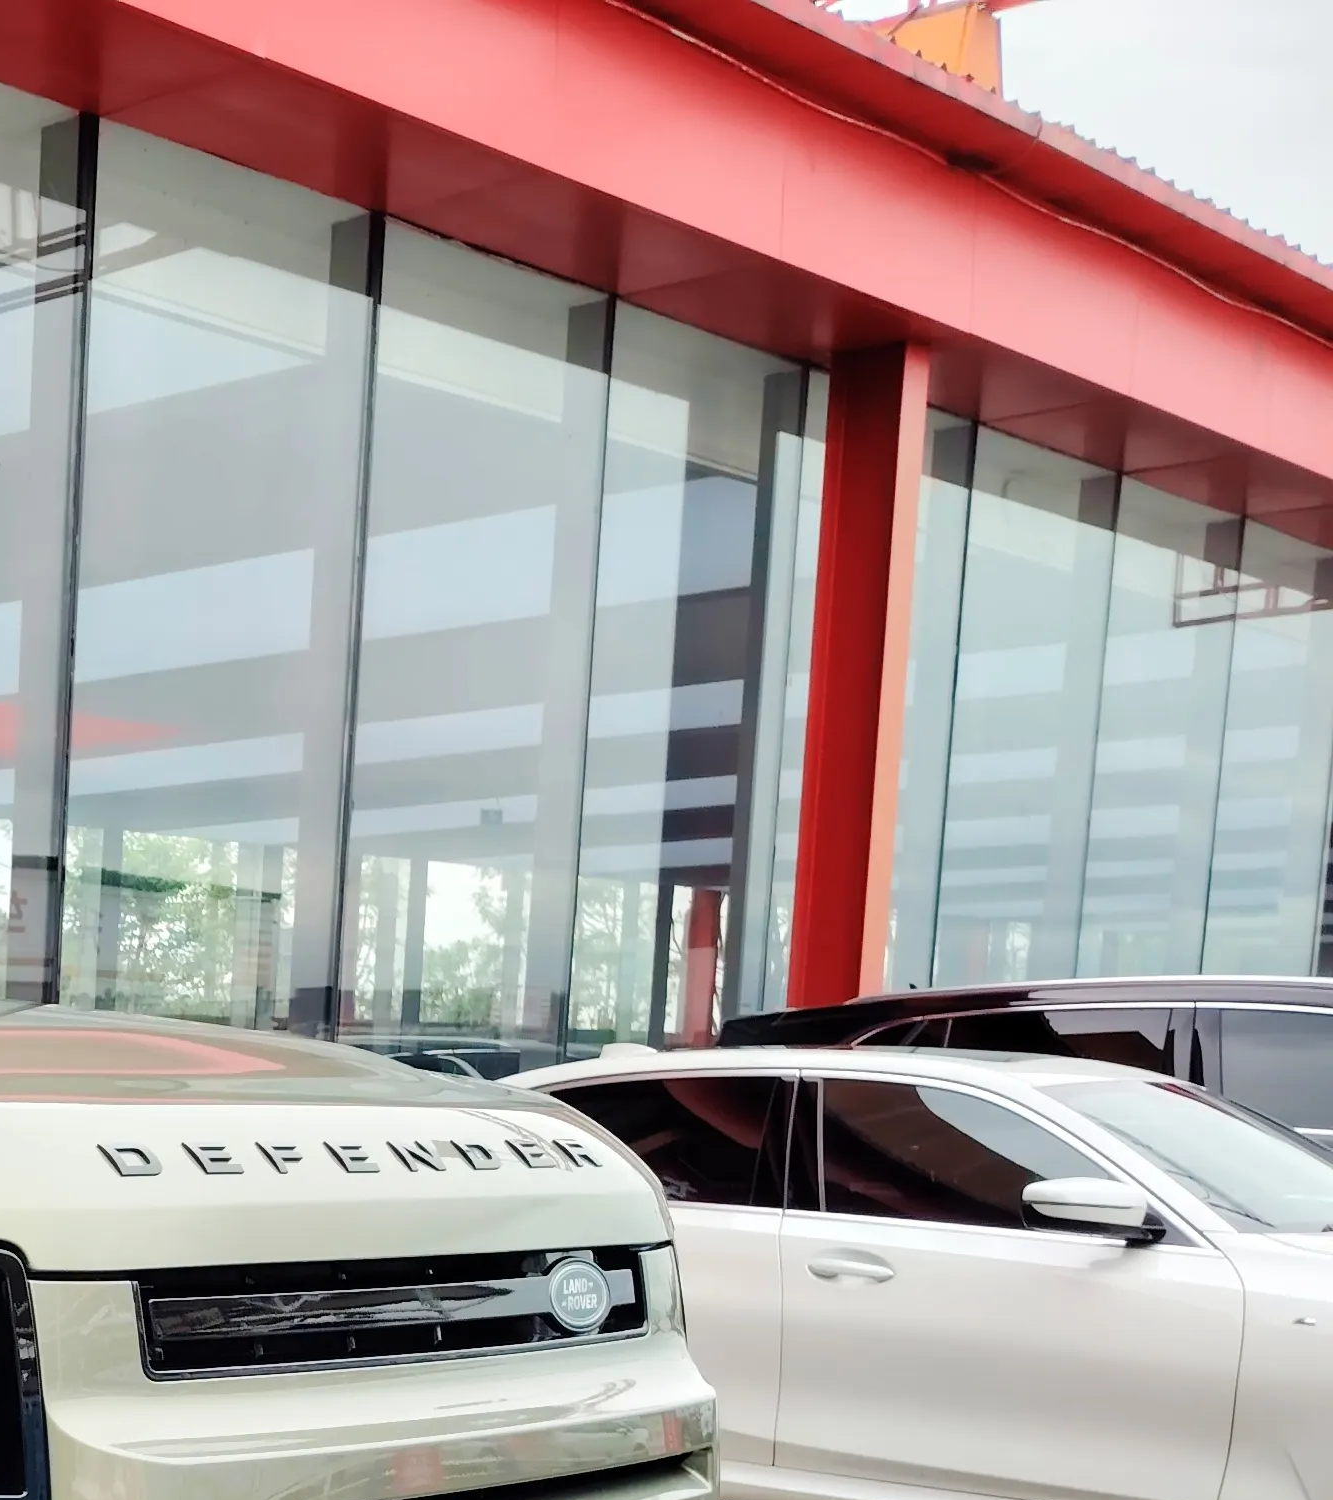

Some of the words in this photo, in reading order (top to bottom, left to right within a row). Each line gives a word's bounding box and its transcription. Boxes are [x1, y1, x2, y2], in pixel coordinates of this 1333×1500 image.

[96, 1138, 603, 1177] DEFENDER
[563, 1278, 588, 1295] LAND
[567, 1293, 598, 1311] ROVER
